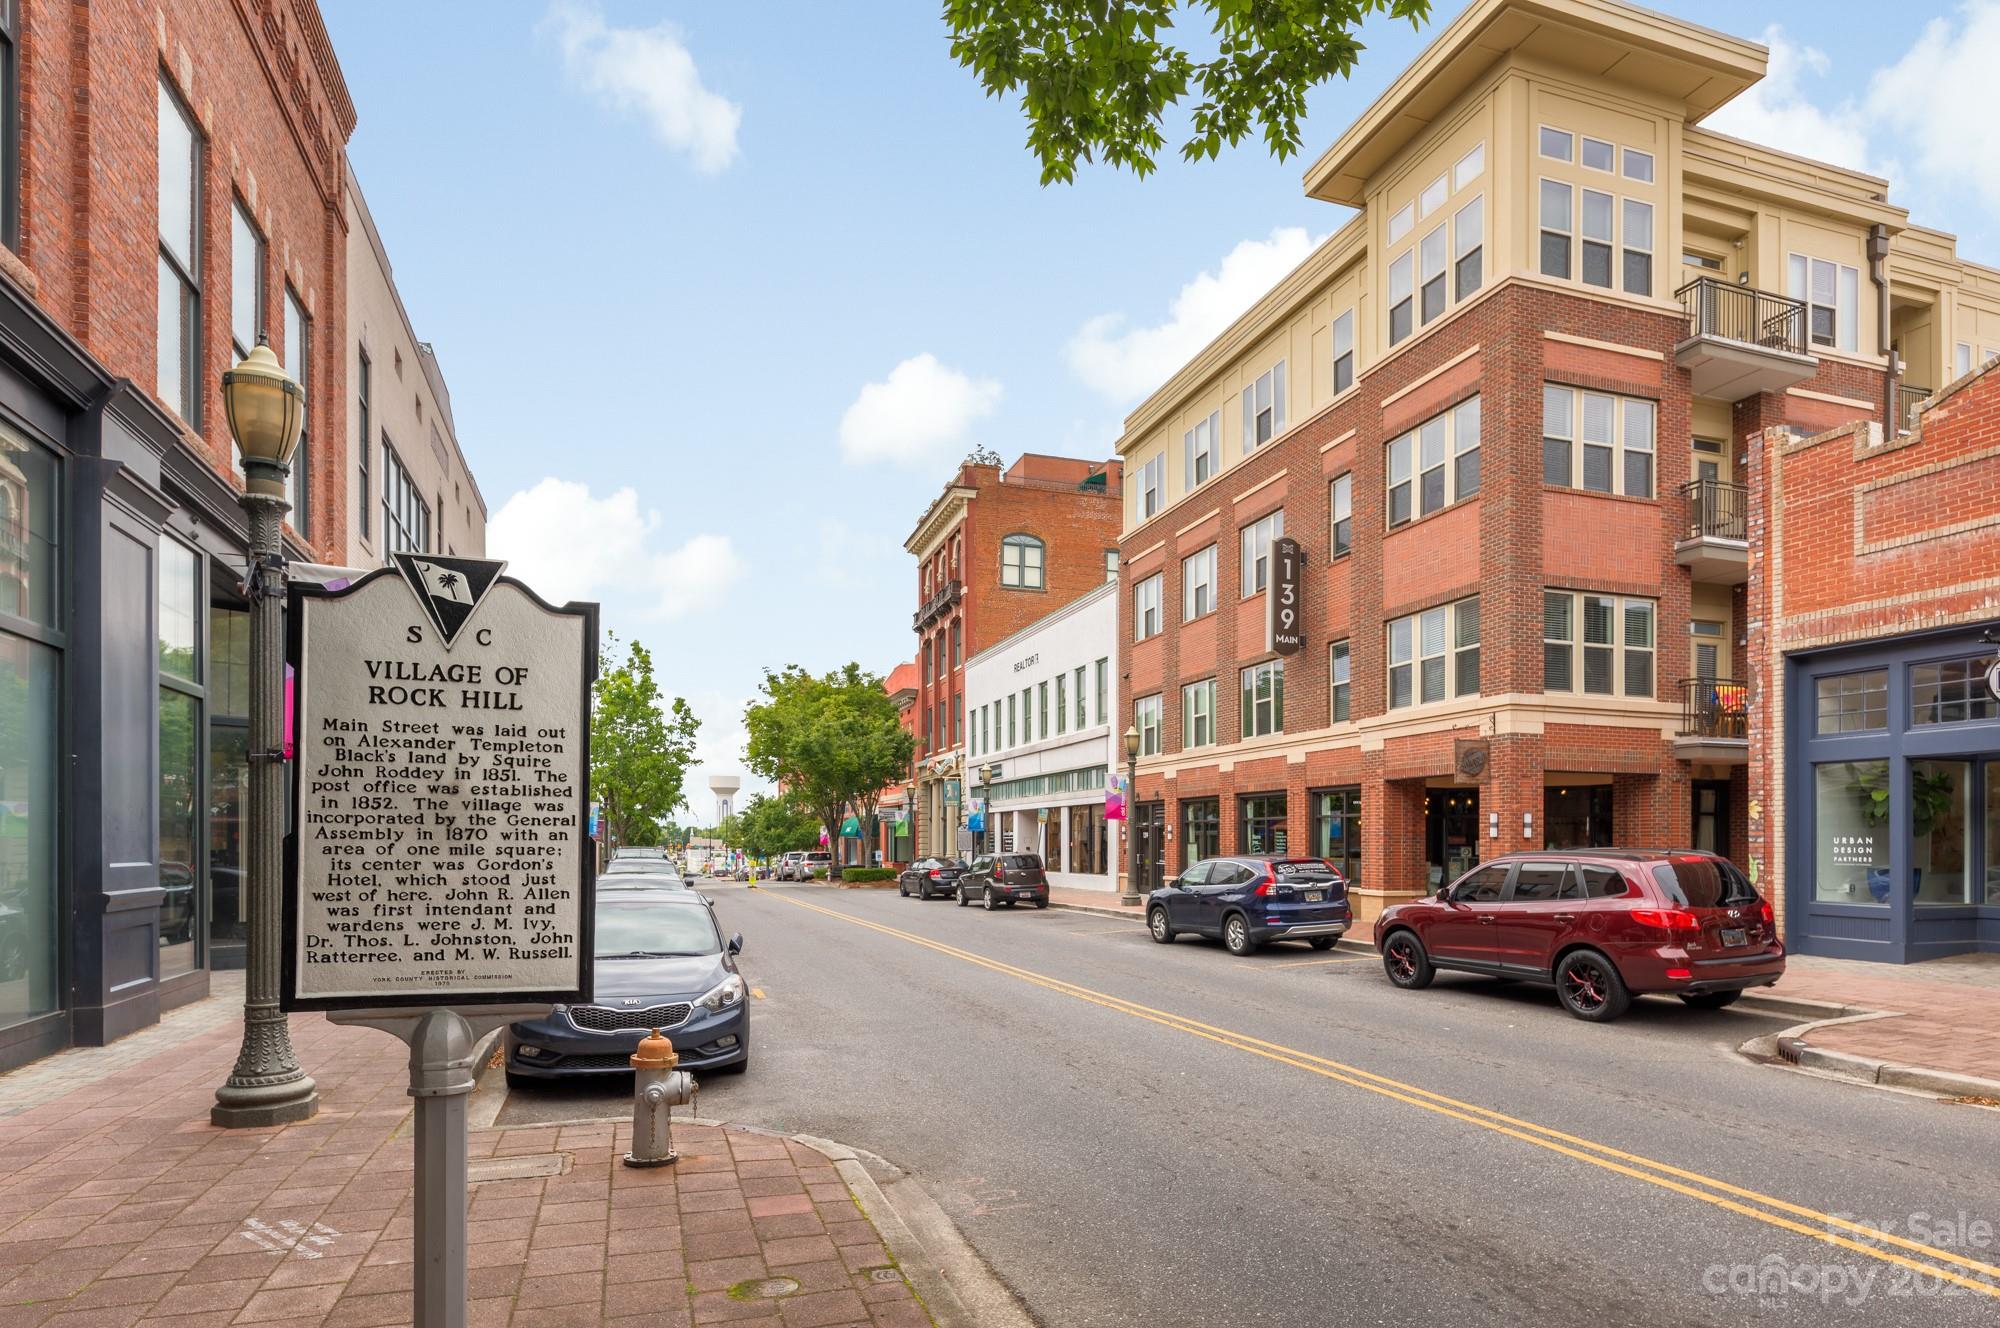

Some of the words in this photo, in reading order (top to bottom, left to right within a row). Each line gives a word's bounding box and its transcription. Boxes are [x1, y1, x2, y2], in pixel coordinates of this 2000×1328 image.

[1281, 559, 1294, 629] 139
[407, 626, 422, 643] S
[476, 629, 491, 646] C
[364, 660, 481, 684] VILLAGE
[495, 667, 528, 686] OF
[369, 686, 446, 707] ROCK
[461, 690, 523, 711] HILL
[323, 718, 368, 732] Main
[382, 720, 439, 734] Street
[452, 726, 483, 736] was
[495, 724, 527, 737] laid
[538, 728, 565, 739] out
[323, 737, 345, 746] on
[358, 734, 455, 750] Alexander
[470, 738, 563, 754] Templeton
[336, 748, 395, 762] Black's
[409, 751, 446, 764] land
[459, 753, 480, 767] by
[493, 754, 551, 769] Squire
[318, 764, 364, 777] John
[376, 766, 444, 781] Roddey
[455, 767, 470, 779] in
[534, 770, 567, 782] The
[312, 780, 349, 794] post
[364, 780, 416, 793] office
[427, 785, 459, 795] was
[471, 785, 572, 797] established
[321, 796, 338, 808] in
[352, 796, 397, 810] 1852.
[413, 798, 448, 810] The
[462, 798, 521, 814] village
[534, 803, 563, 811] was
[308, 810, 424, 826] incorporated
[435, 813, 455, 828] by
[468, 814, 496, 825] the
[507, 815, 575, 828] General
[315, 826, 404, 842] Assembly
[417, 828, 433, 840] in
[445, 827, 487, 840] 1870
[501, 828, 538, 840] with
[549, 832, 568, 840] an
[1833, 836, 1873, 844] URBAN
[322, 845, 364, 855] area
[376, 843, 395, 855] of
[407, 846, 440, 855] one
[449, 844, 484, 855] mile
[496, 847, 561, 862] square;
[1833, 846, 1873, 854] DESIGN
[331, 858, 351, 871] its
[362, 859, 421, 870] center
[433, 862, 464, 870] was
[477, 859, 553, 870] Gordon's
[395, 874, 447, 886] which
[462, 874, 510, 885] stood
[522, 873, 555, 887] just
[312, 890, 351, 901] west
[359, 889, 377, 901] of
[445, 889, 488, 900] John
[498, 888, 513, 900] R.
[523, 887, 569, 899] Allen
[327, 907, 359, 916] was
[373, 904, 412, 916] first
[425, 903, 512, 915] intendant
[525, 903, 555, 914] and
[327, 920, 404, 932] wardens
[418, 921, 460, 930] were
[471, 918, 485, 930] J.
[494, 918, 512, 930] M.
[524, 918, 555, 931] Ivy,
[307, 935, 333, 948] Dr.
[344, 935, 392, 947] Thos.
[404, 934, 419, 946] L.
[531, 932, 572, 944] John
[413, 949, 445, 961] and
[455, 948, 474, 960] M.
[482, 948, 500, 960] W.
[509, 947, 572, 959] Russell.
